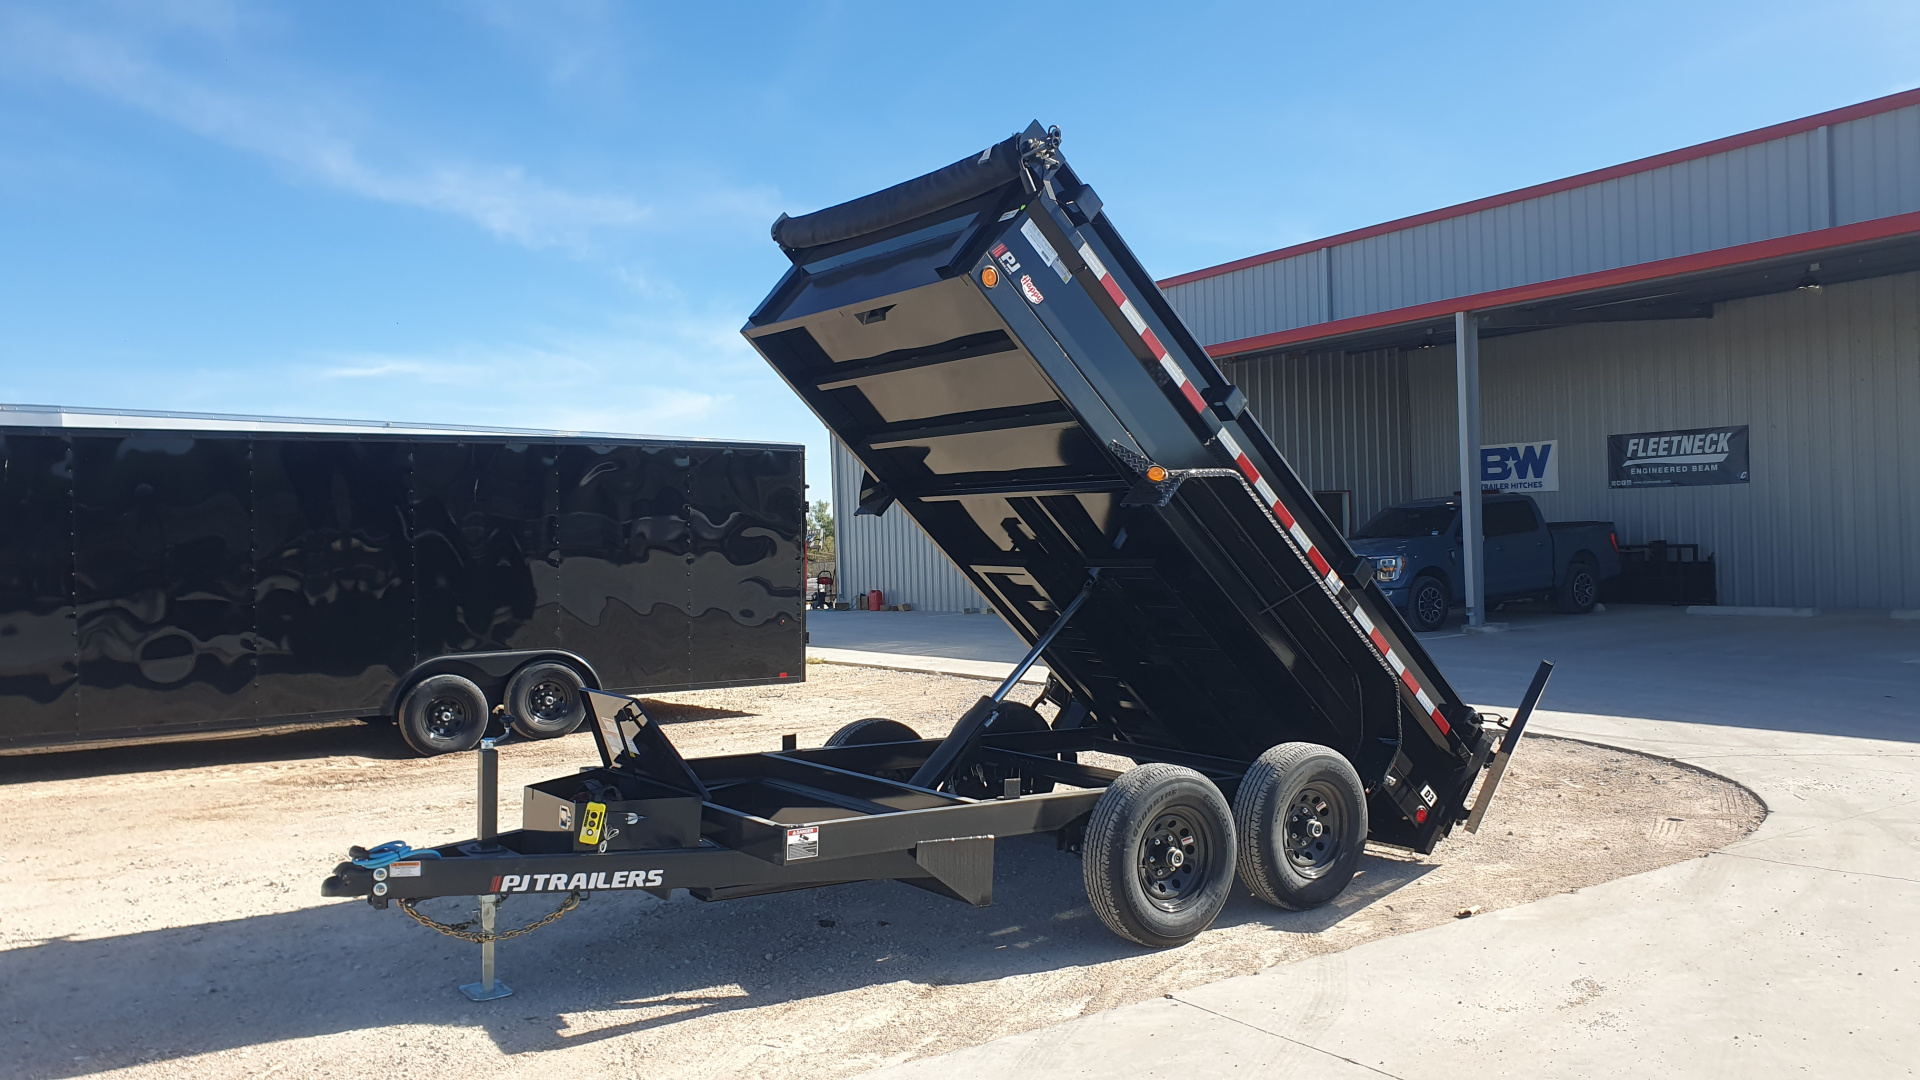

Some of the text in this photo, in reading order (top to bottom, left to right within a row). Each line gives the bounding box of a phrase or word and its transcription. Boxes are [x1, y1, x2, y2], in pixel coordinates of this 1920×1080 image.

[1000, 251, 1021, 273] PJ
[1022, 275, 1043, 304] Happy
[1627, 432, 1732, 458] FLEETNECK
[1631, 464, 1718, 475] ENGINEERED BEAM
[1511, 481, 1543, 489] HITCHES
[1424, 789, 1434, 802] D3
[500, 870, 664, 892] PJ TRAILERS
